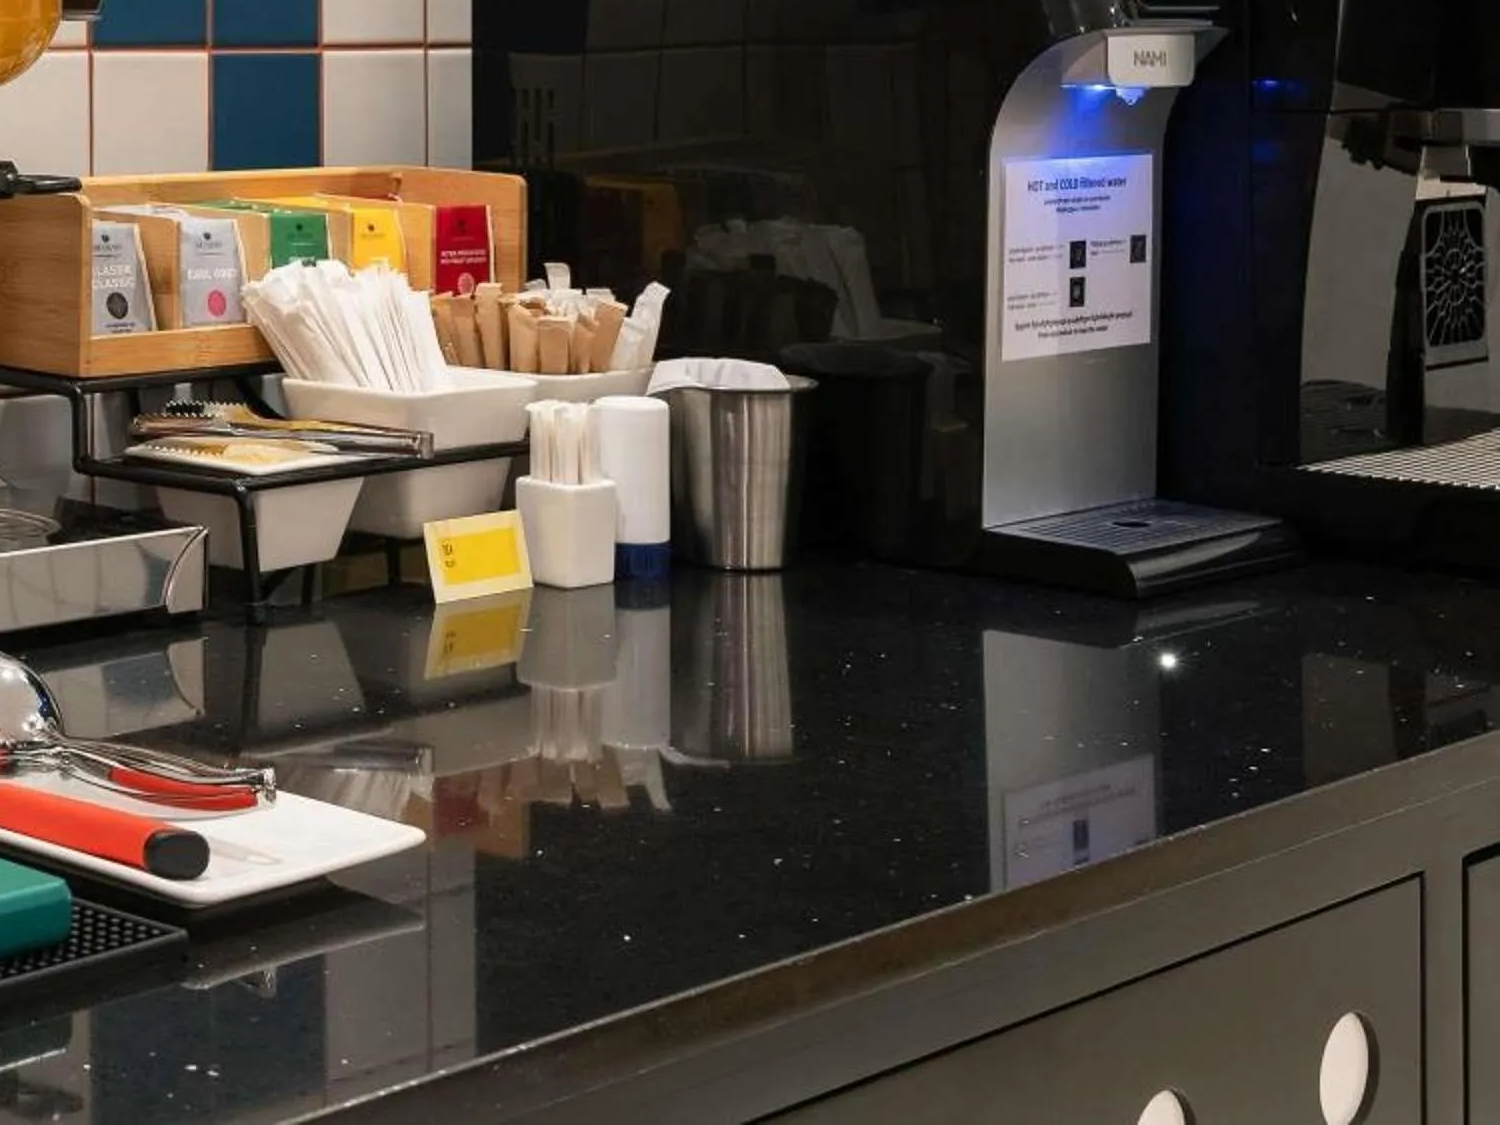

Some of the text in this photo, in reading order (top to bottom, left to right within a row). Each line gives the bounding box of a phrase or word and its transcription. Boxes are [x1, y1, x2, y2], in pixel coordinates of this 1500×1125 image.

[1133, 50, 1168, 67] NAMI
[1027, 179, 1044, 192] HOT
[1045, 178, 1058, 191] and
[1060, 178, 1079, 190] COLD
